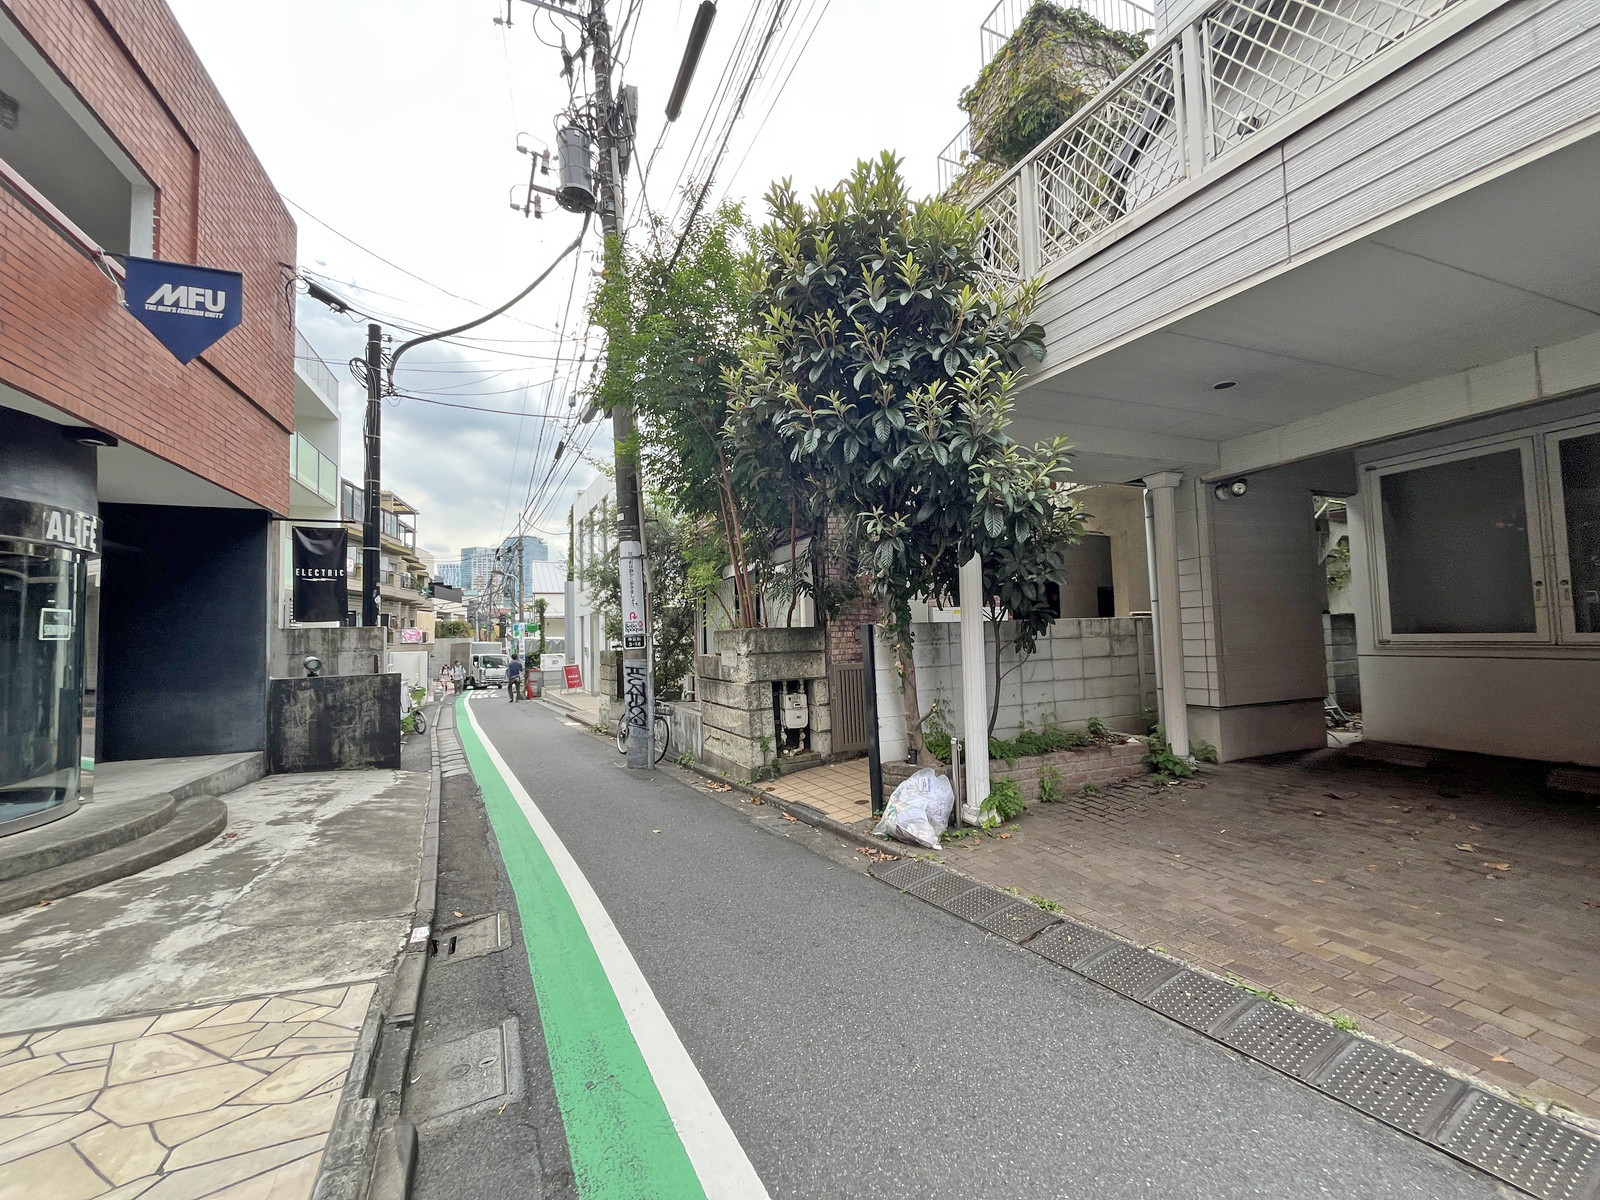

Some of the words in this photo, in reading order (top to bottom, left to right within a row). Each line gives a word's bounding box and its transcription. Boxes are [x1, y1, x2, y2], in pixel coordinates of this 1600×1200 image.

[145, 283, 226, 312] MFU
[144, 303, 157, 311] THE
[157, 305, 177, 314] MEN'S
[177, 307, 204, 317] FASHION
[204, 311, 224, 319] UNITY
[295, 568, 345, 577] ELECTRIC
